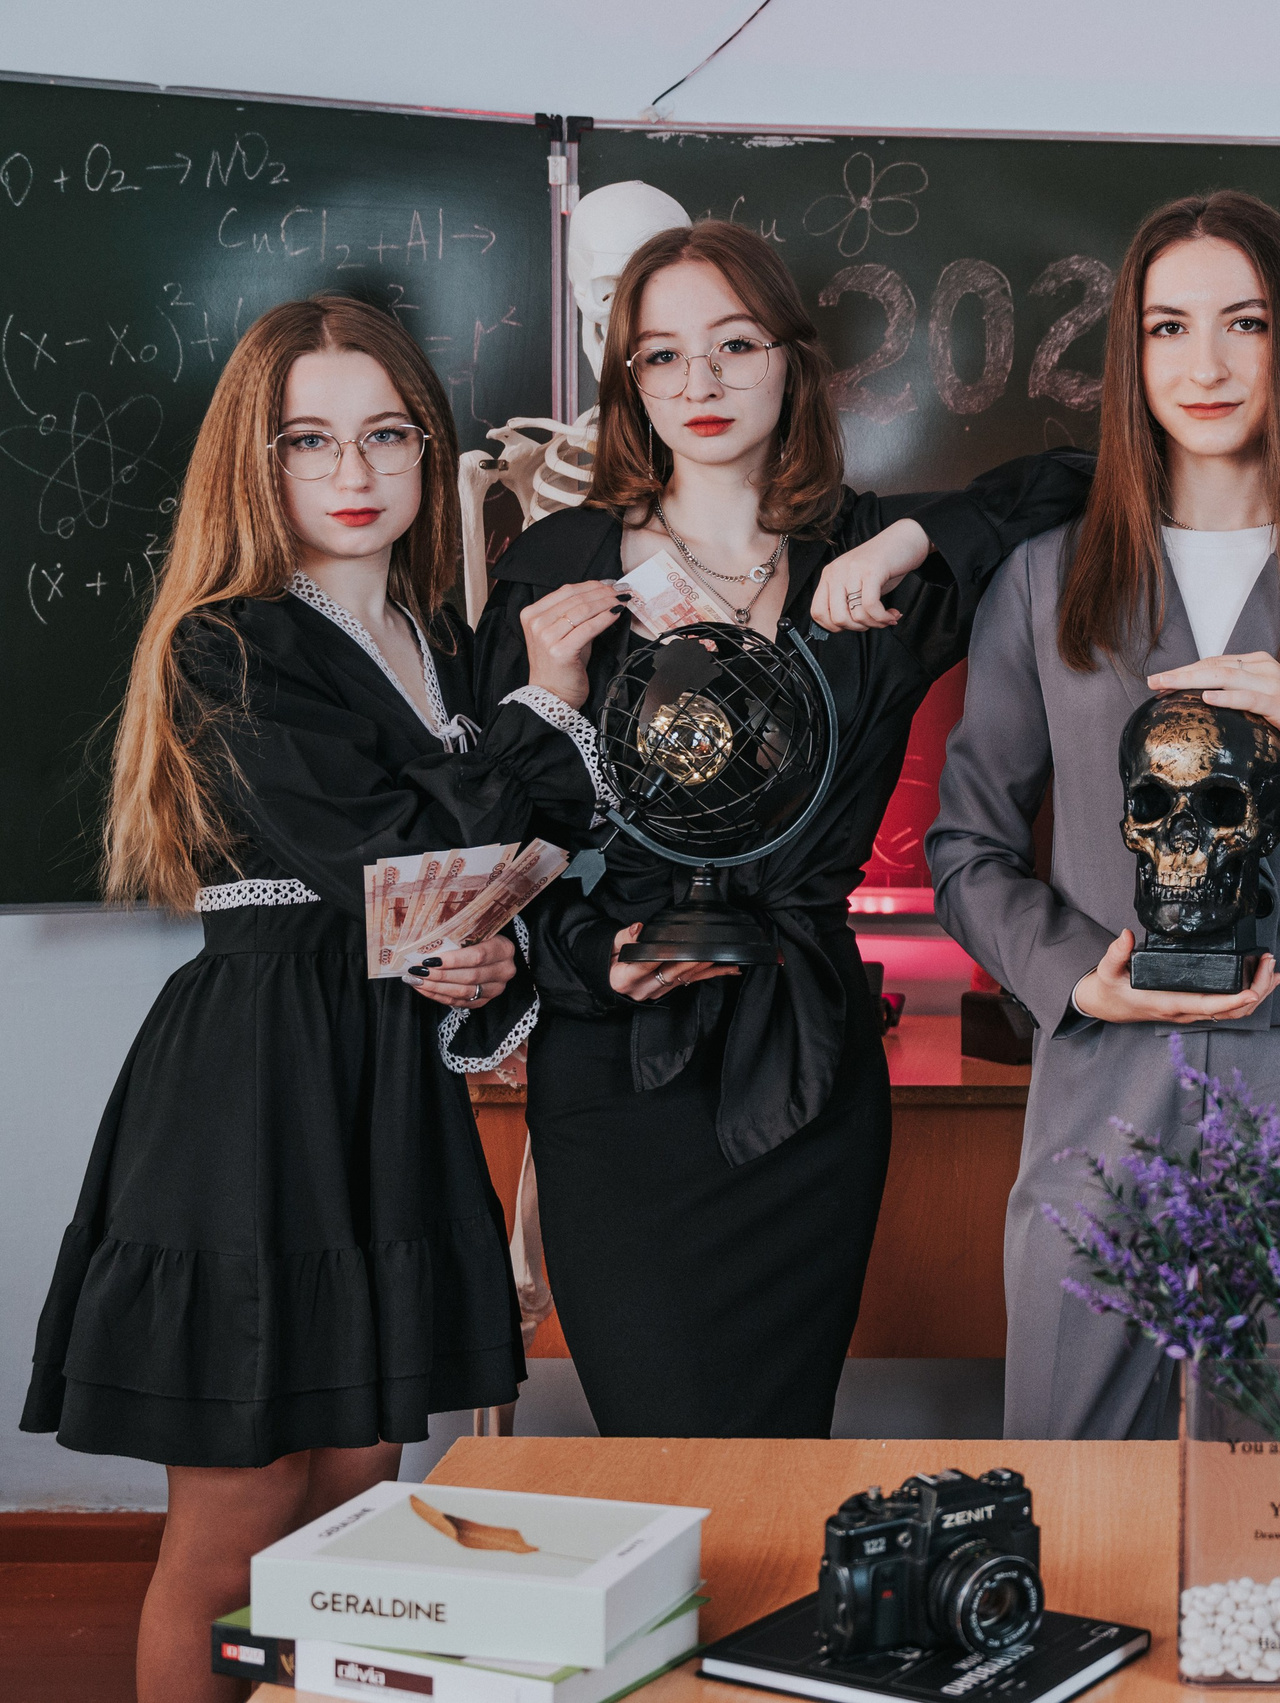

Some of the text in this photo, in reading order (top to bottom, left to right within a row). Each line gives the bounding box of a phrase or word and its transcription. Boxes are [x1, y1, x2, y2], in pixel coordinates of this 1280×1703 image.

[1227, 1438, 1265, 1455] You
[941, 1504, 996, 1529] ZENIT
[310, 1591, 447, 1622] GERALDINE
